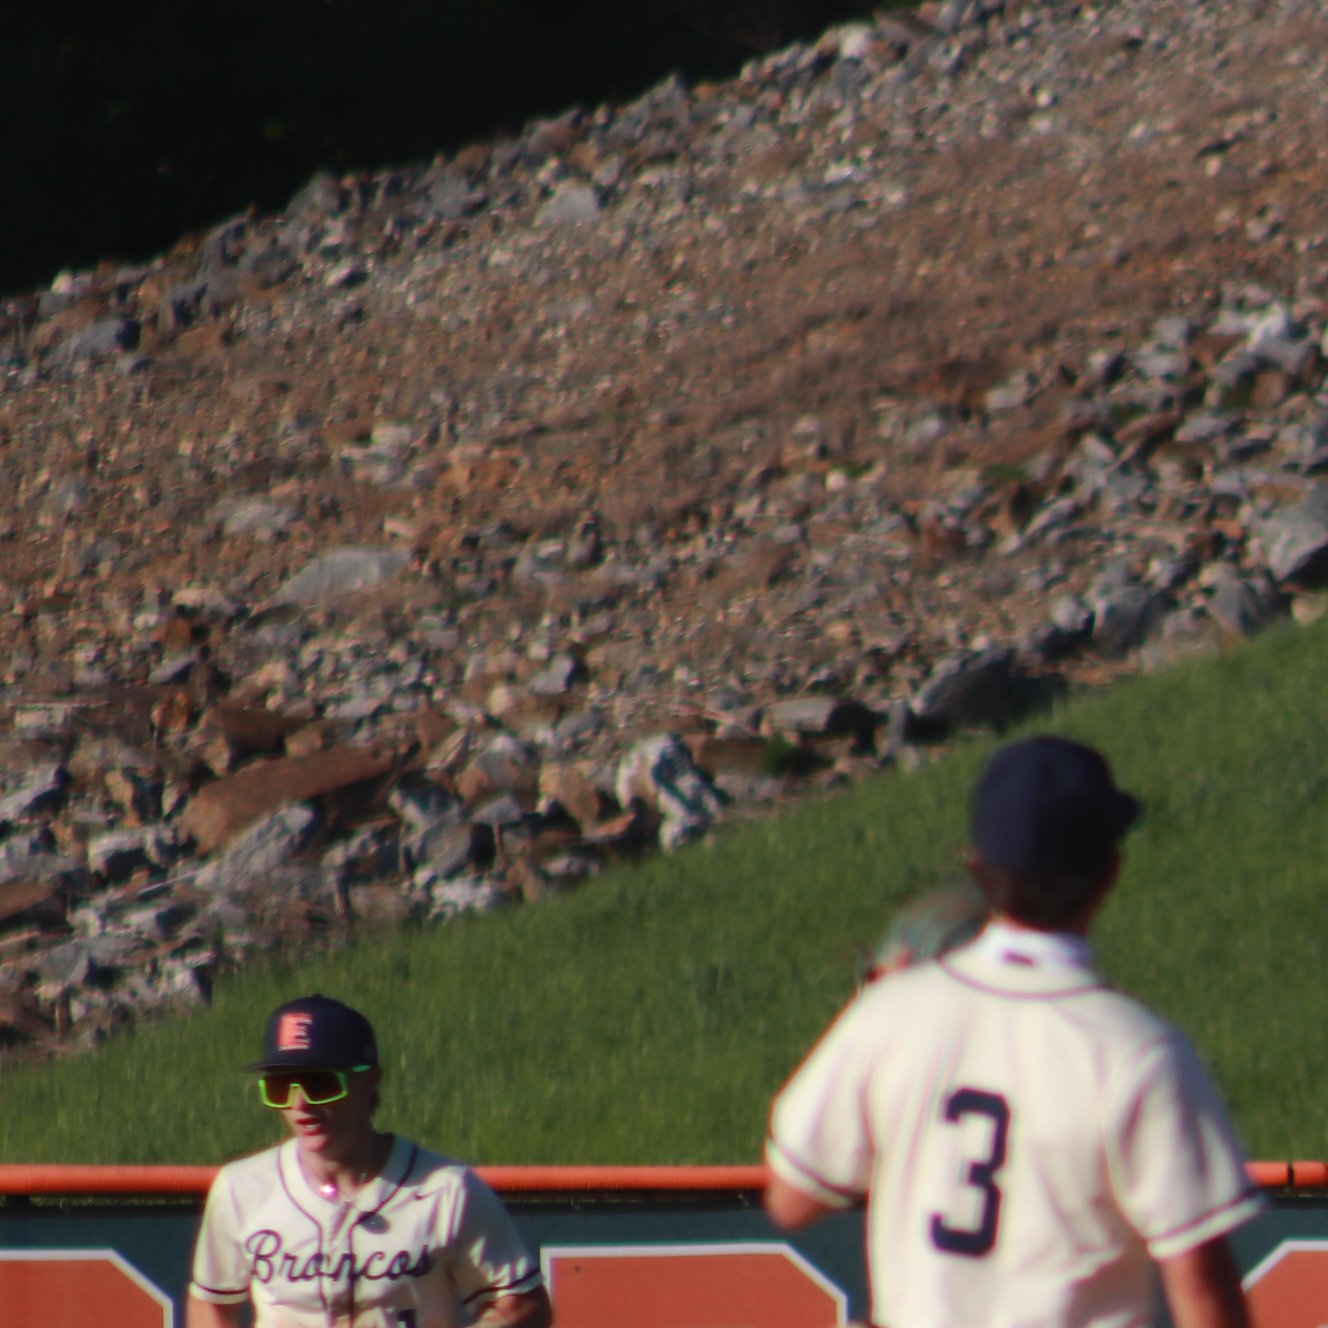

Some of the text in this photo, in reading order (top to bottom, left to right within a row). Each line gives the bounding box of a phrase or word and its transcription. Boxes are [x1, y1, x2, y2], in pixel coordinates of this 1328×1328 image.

[278, 1012, 313, 1052] E
[928, 1086, 1011, 1258] 3
[245, 1229, 434, 1283] Broncos
